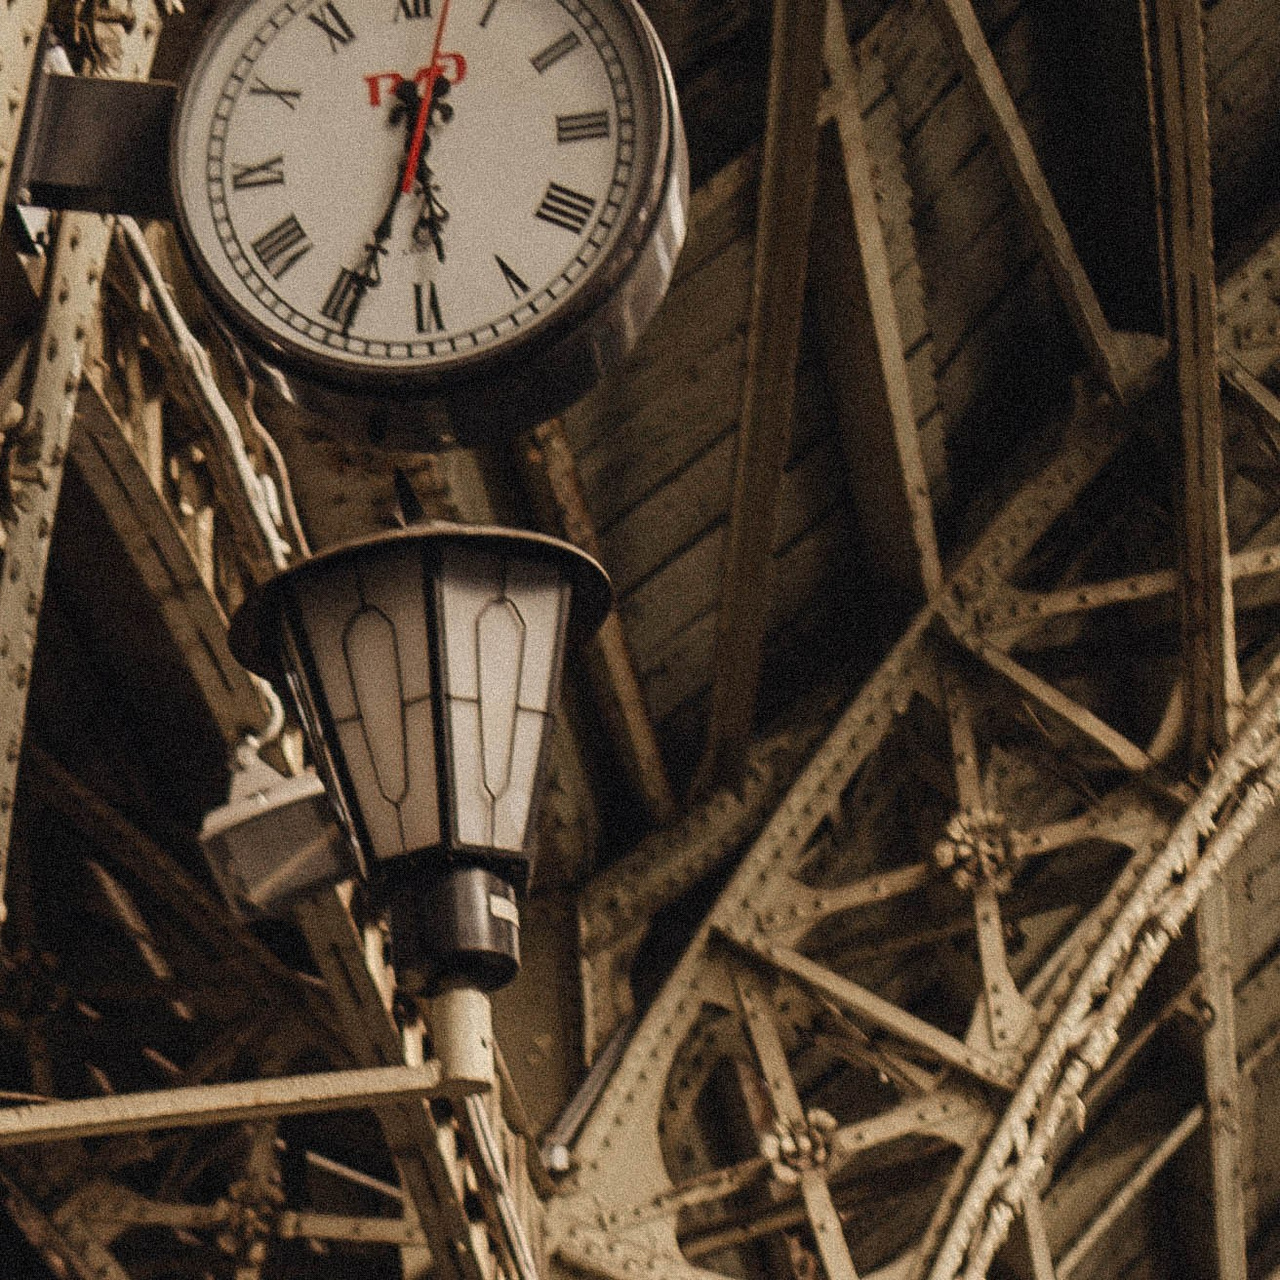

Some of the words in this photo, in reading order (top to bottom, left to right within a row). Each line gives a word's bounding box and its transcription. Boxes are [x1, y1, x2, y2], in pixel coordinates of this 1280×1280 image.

[530, 30, 582, 74] II
[249, 76, 302, 111] X
[556, 110, 610, 145] III
[231, 155, 285, 190] IX
[251, 212, 314, 280] VIII
[494, 254, 531, 299] V
[413, 280, 446, 333] VI
